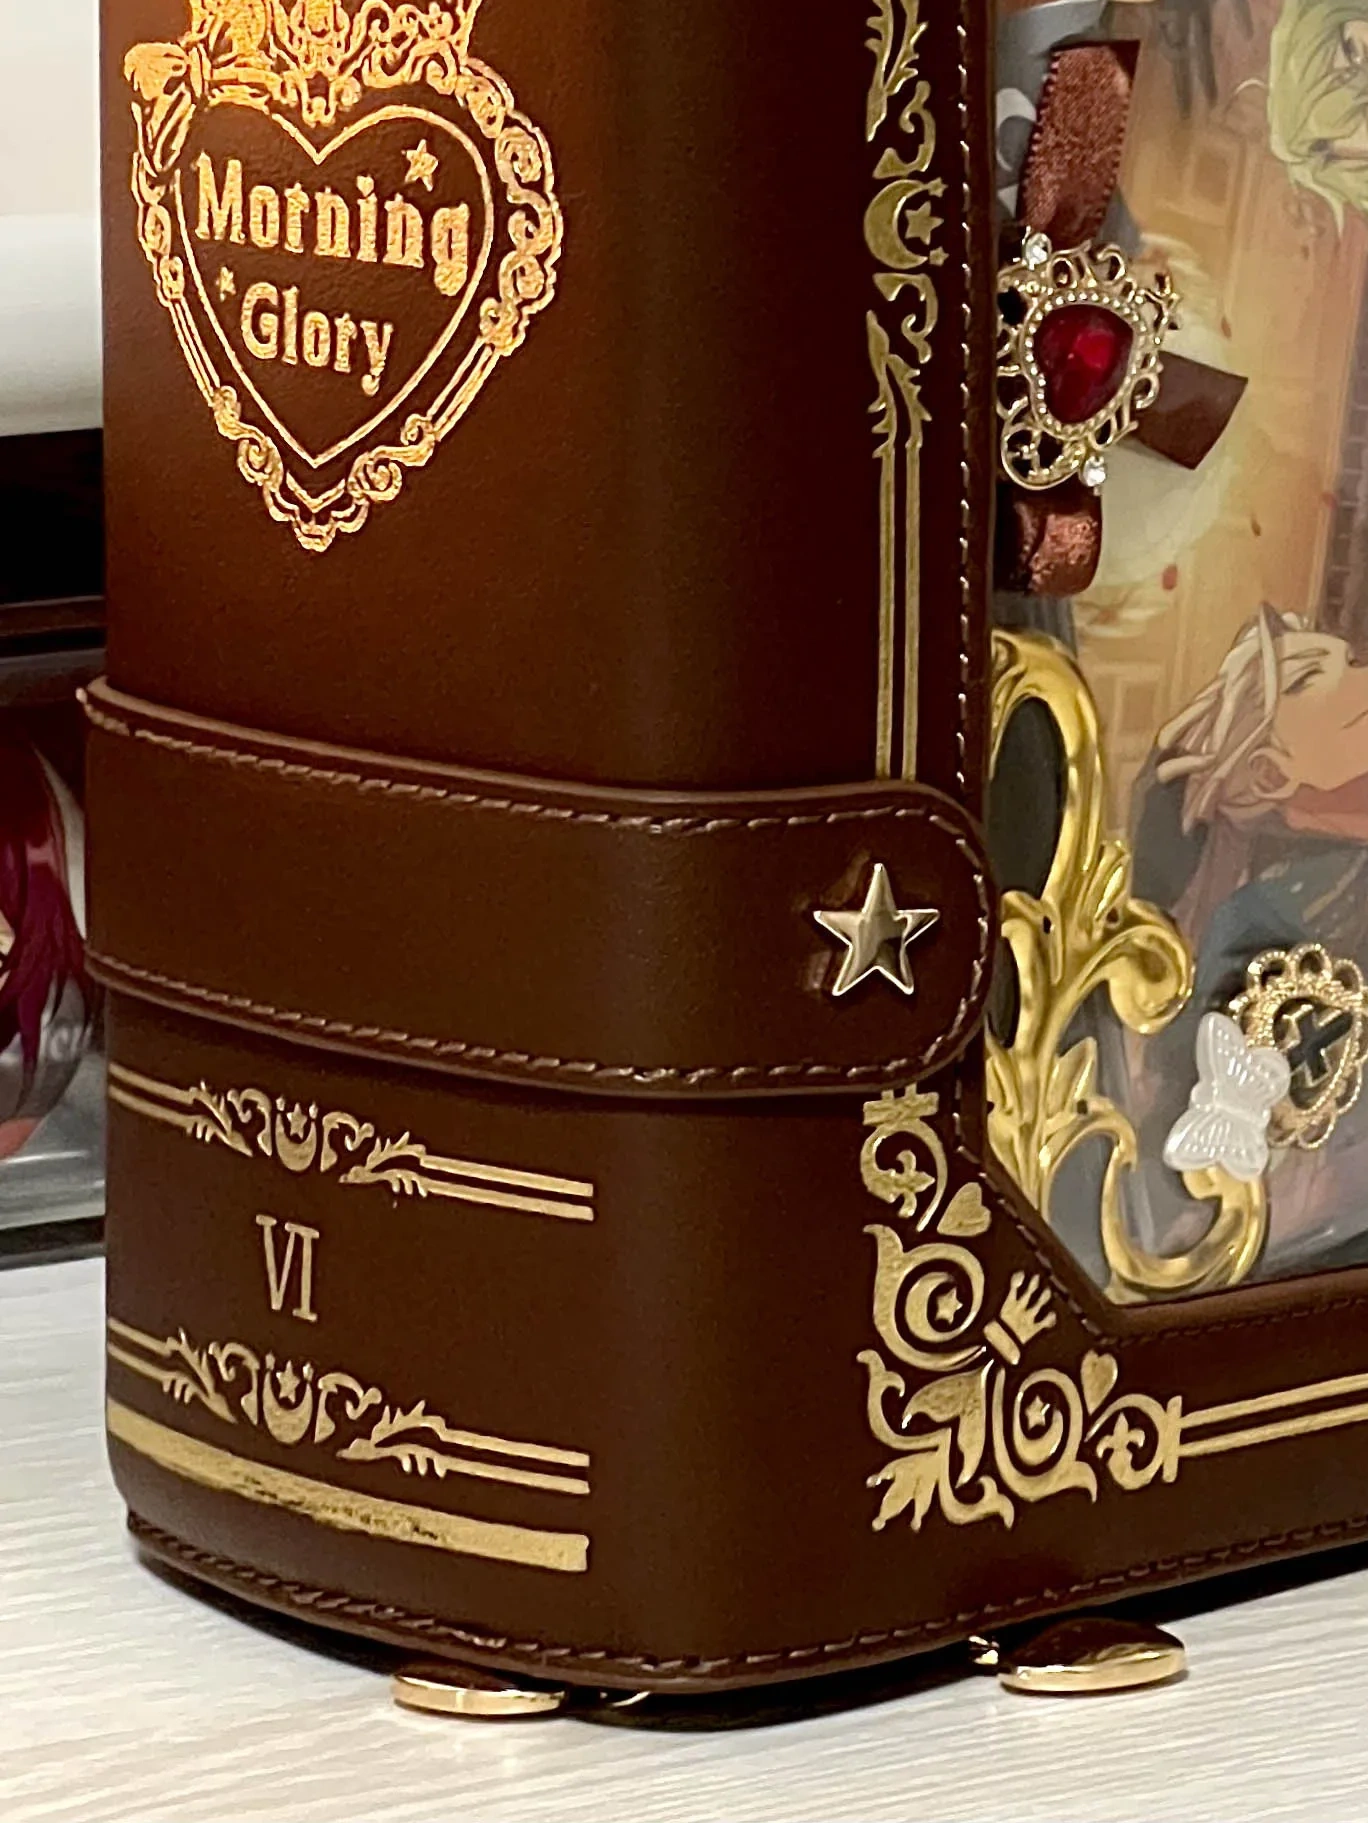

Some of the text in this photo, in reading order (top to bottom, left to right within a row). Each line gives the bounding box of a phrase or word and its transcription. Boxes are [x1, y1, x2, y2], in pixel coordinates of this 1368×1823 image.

[195, 151, 470, 296] Morning
[240, 282, 393, 396] Glory
[256, 1215, 320, 1322] VI
